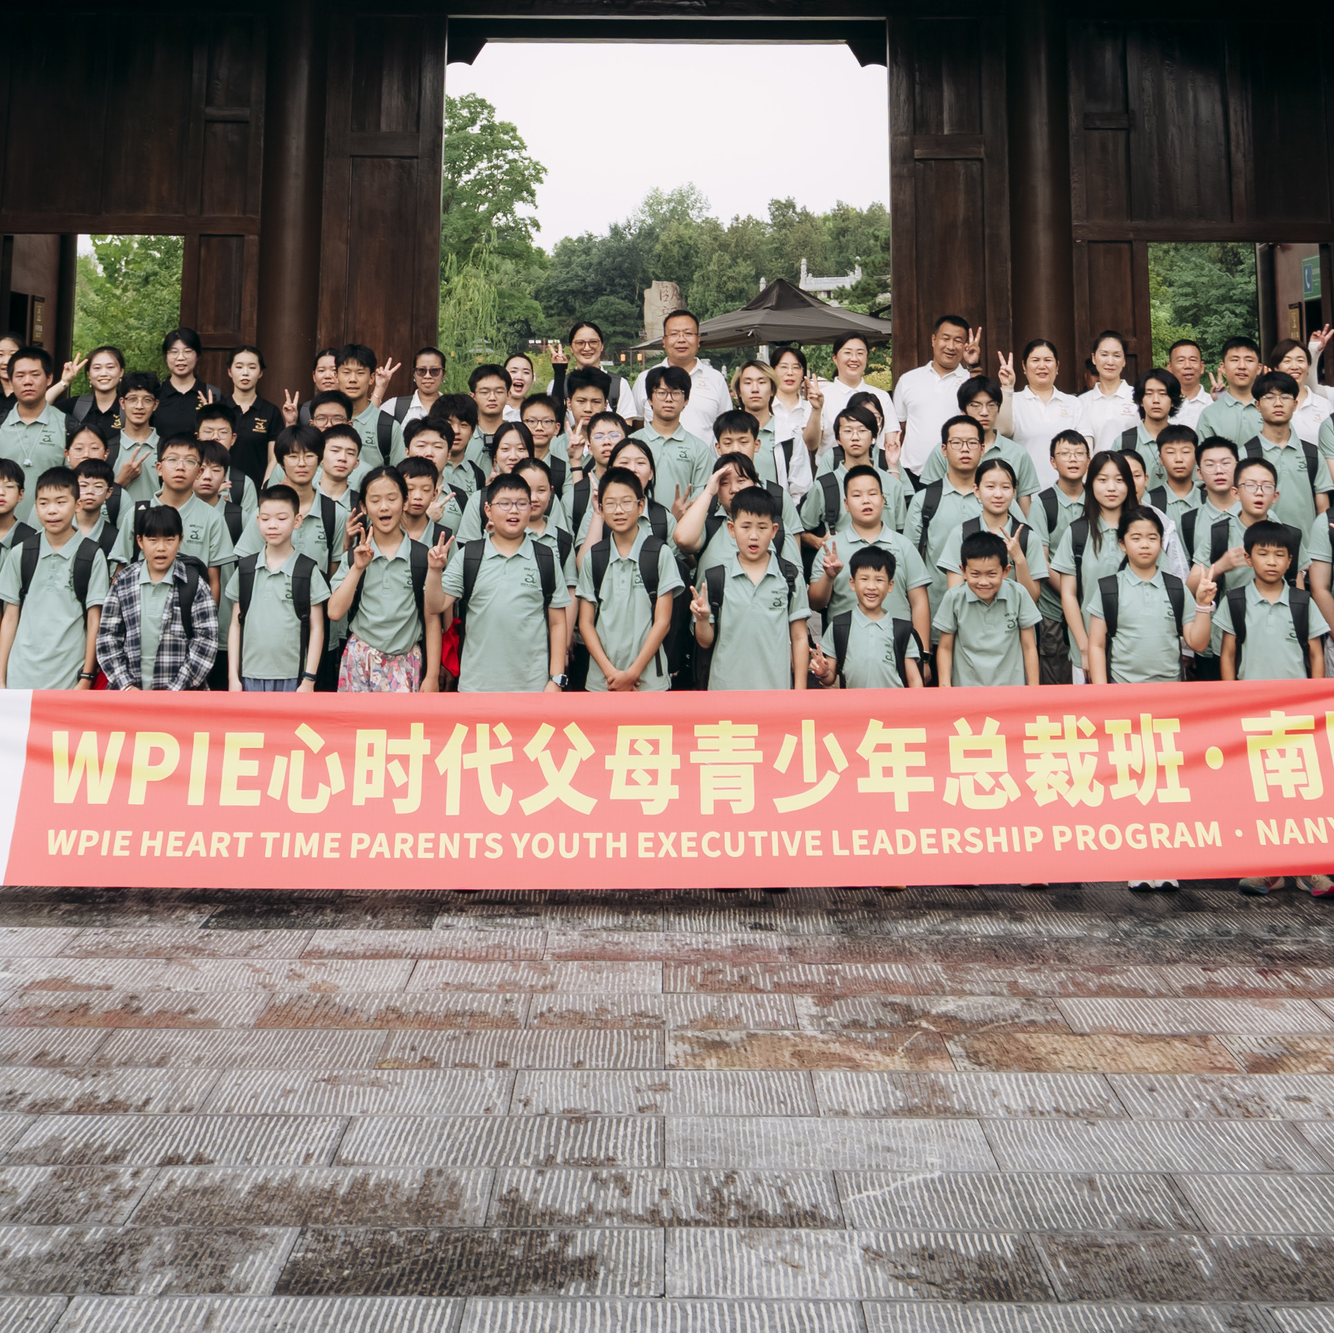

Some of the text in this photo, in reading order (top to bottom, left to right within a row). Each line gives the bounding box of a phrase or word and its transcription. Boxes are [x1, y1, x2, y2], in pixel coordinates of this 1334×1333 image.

[47, 829, 133, 857] WPIE
[139, 830, 254, 858] HEART
[260, 832, 342, 859] TIME
[350, 832, 506, 860] PARENTS
[510, 832, 627, 860] YOUTH
[637, 830, 823, 859] EXECUTIVE
[831, 824, 1044, 856] LEADERSHIP
[1053, 820, 1222, 852] PROGRAM
